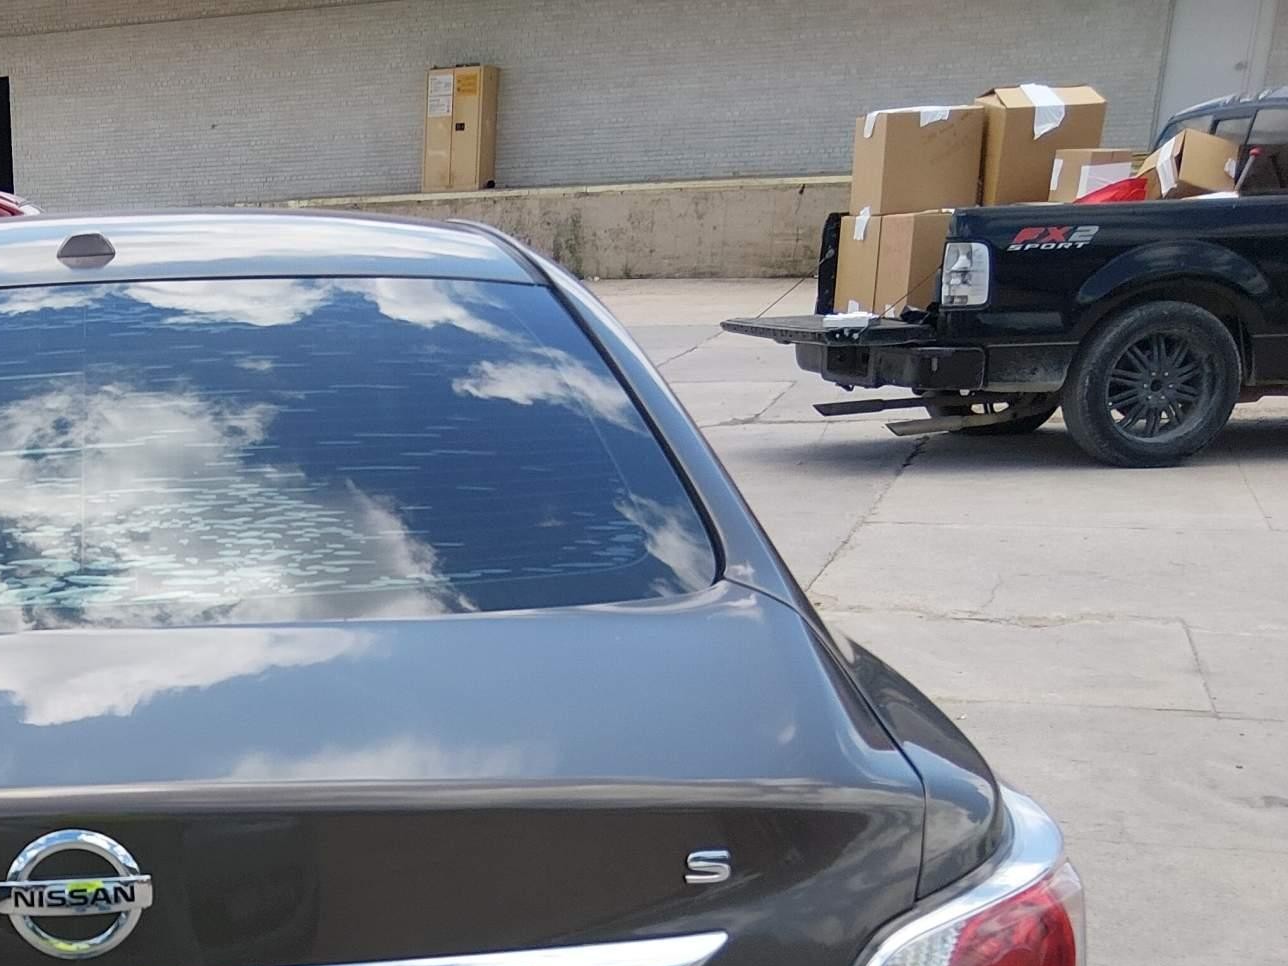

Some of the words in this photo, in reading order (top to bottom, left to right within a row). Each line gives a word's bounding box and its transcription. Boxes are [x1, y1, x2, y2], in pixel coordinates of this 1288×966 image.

[1013, 225, 1100, 244] FX2
[1006, 241, 1091, 252] SPORT
[685, 850, 731, 884] S
[14, 884, 135, 908] NISSAN
